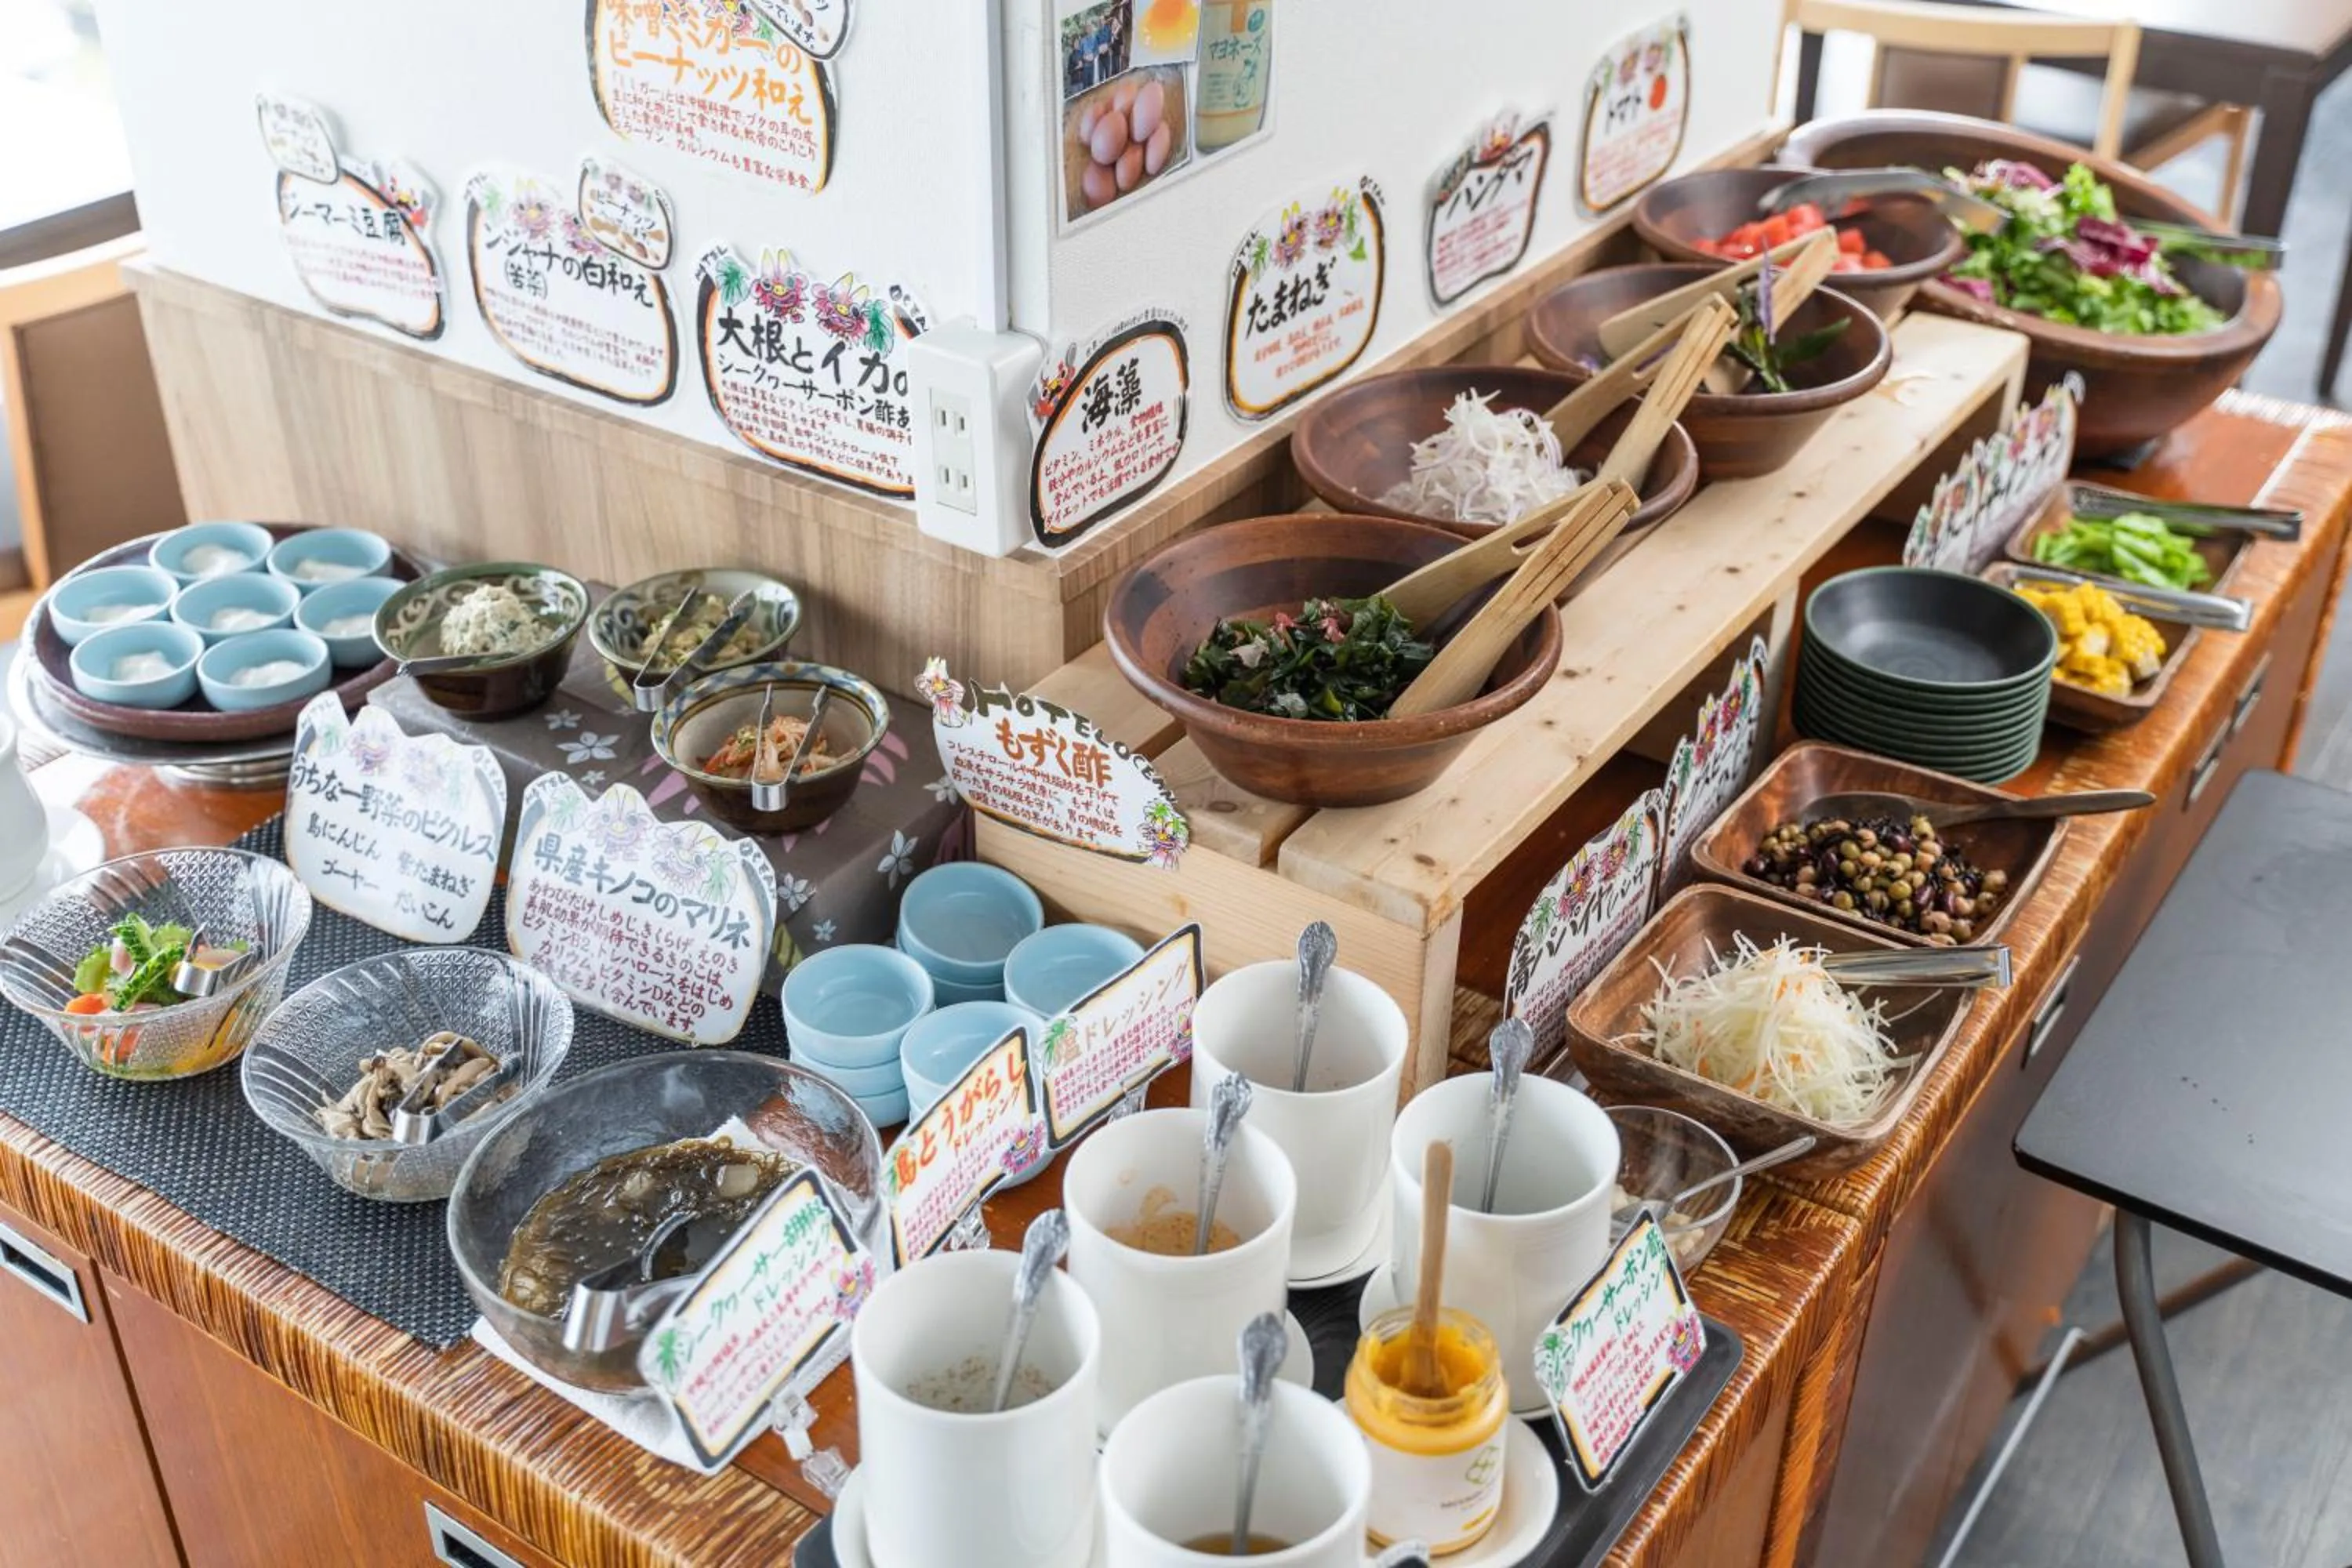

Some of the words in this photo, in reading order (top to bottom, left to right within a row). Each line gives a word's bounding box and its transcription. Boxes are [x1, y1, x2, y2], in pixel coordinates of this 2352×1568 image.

[1245, 256, 1337, 340] たまねぎ
[1081, 357, 1142, 434] 海藻
[970, 678, 1110, 749] HOTEL
[995, 717, 1114, 789] もずく酢
[292, 757, 495, 863] うちなー野菜のピクルス
[306, 812, 382, 862] 島にんじん
[321, 858, 381, 891] ゴーヤー
[534, 832, 751, 951] 県産キノコのマリネ
[895, 1053, 1026, 1192] 島とうがらし
